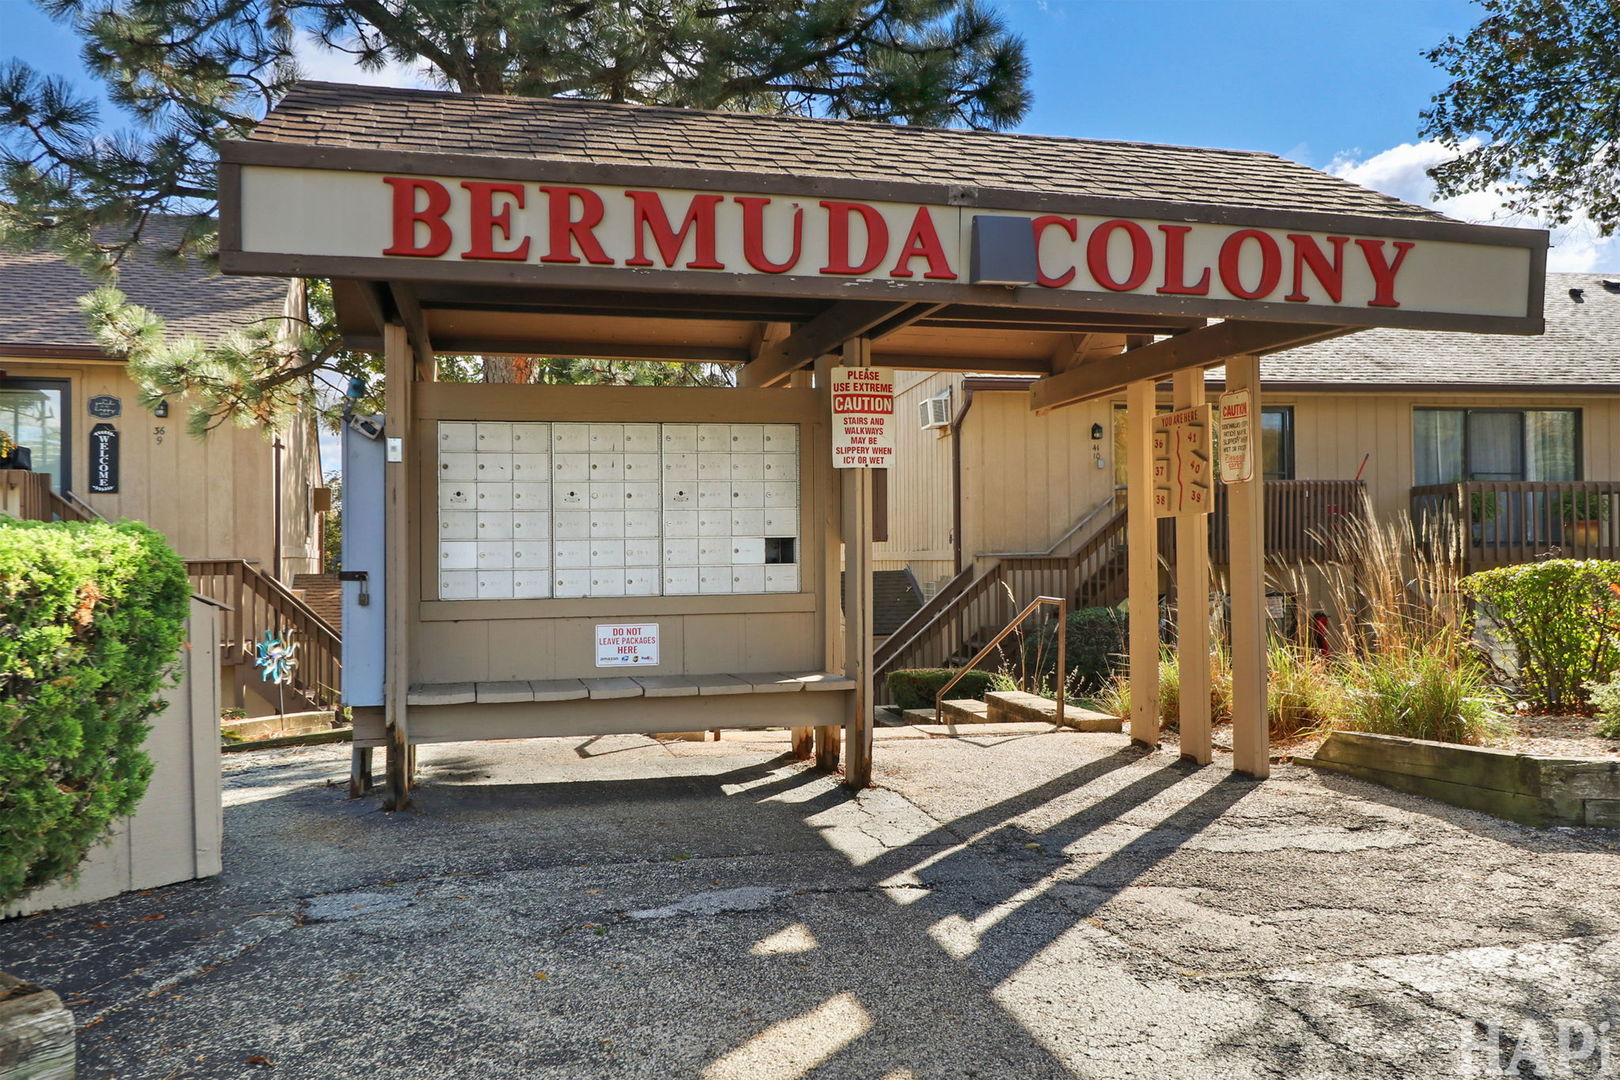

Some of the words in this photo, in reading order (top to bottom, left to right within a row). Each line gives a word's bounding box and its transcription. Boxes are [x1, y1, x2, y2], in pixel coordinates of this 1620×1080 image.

[383, 177, 957, 280] BERMUDA
[1031, 214, 1415, 306] COLONY
[847, 371, 879, 380] PLEASE
[833, 383, 850, 392] USE
[853, 383, 893, 393] EXTREME
[835, 397, 892, 412] CAUTION
[1222, 403, 1247, 417] CAUTION
[843, 417, 868, 425] STAIRS
[870, 418, 884, 426] AND
[1161, 417, 1173, 427] YOU
[1173, 413, 1183, 424] ARE
[1183, 409, 1198, 422] HERE
[153, 426, 165, 435] 36
[844, 427, 883, 435] WALKWAYS
[156, 436, 163, 445] 9
[850, 437, 865, 445] MAY
[868, 437, 877, 445] BE
[1187, 432, 1197, 443] 41
[1154, 439, 1163, 449] 36
[836, 447, 870, 455] SLIPPERY
[872, 447, 892, 455] WHEN
[99, 435, 109, 487] WELCOME
[843, 456, 855, 464] ICY
[857, 456, 867, 464] OR
[1155, 466, 1164, 476] 37
[1190, 460, 1200, 474] 40
[1156, 494, 1165, 505] 38
[1191, 490, 1201, 503] 39
[612, 628, 624, 636] DO
[626, 627, 641, 635] NOT
[599, 637, 620, 645] LEAVE
[622, 637, 656, 645] PACKAGES
[617, 646, 638, 654] HERE
